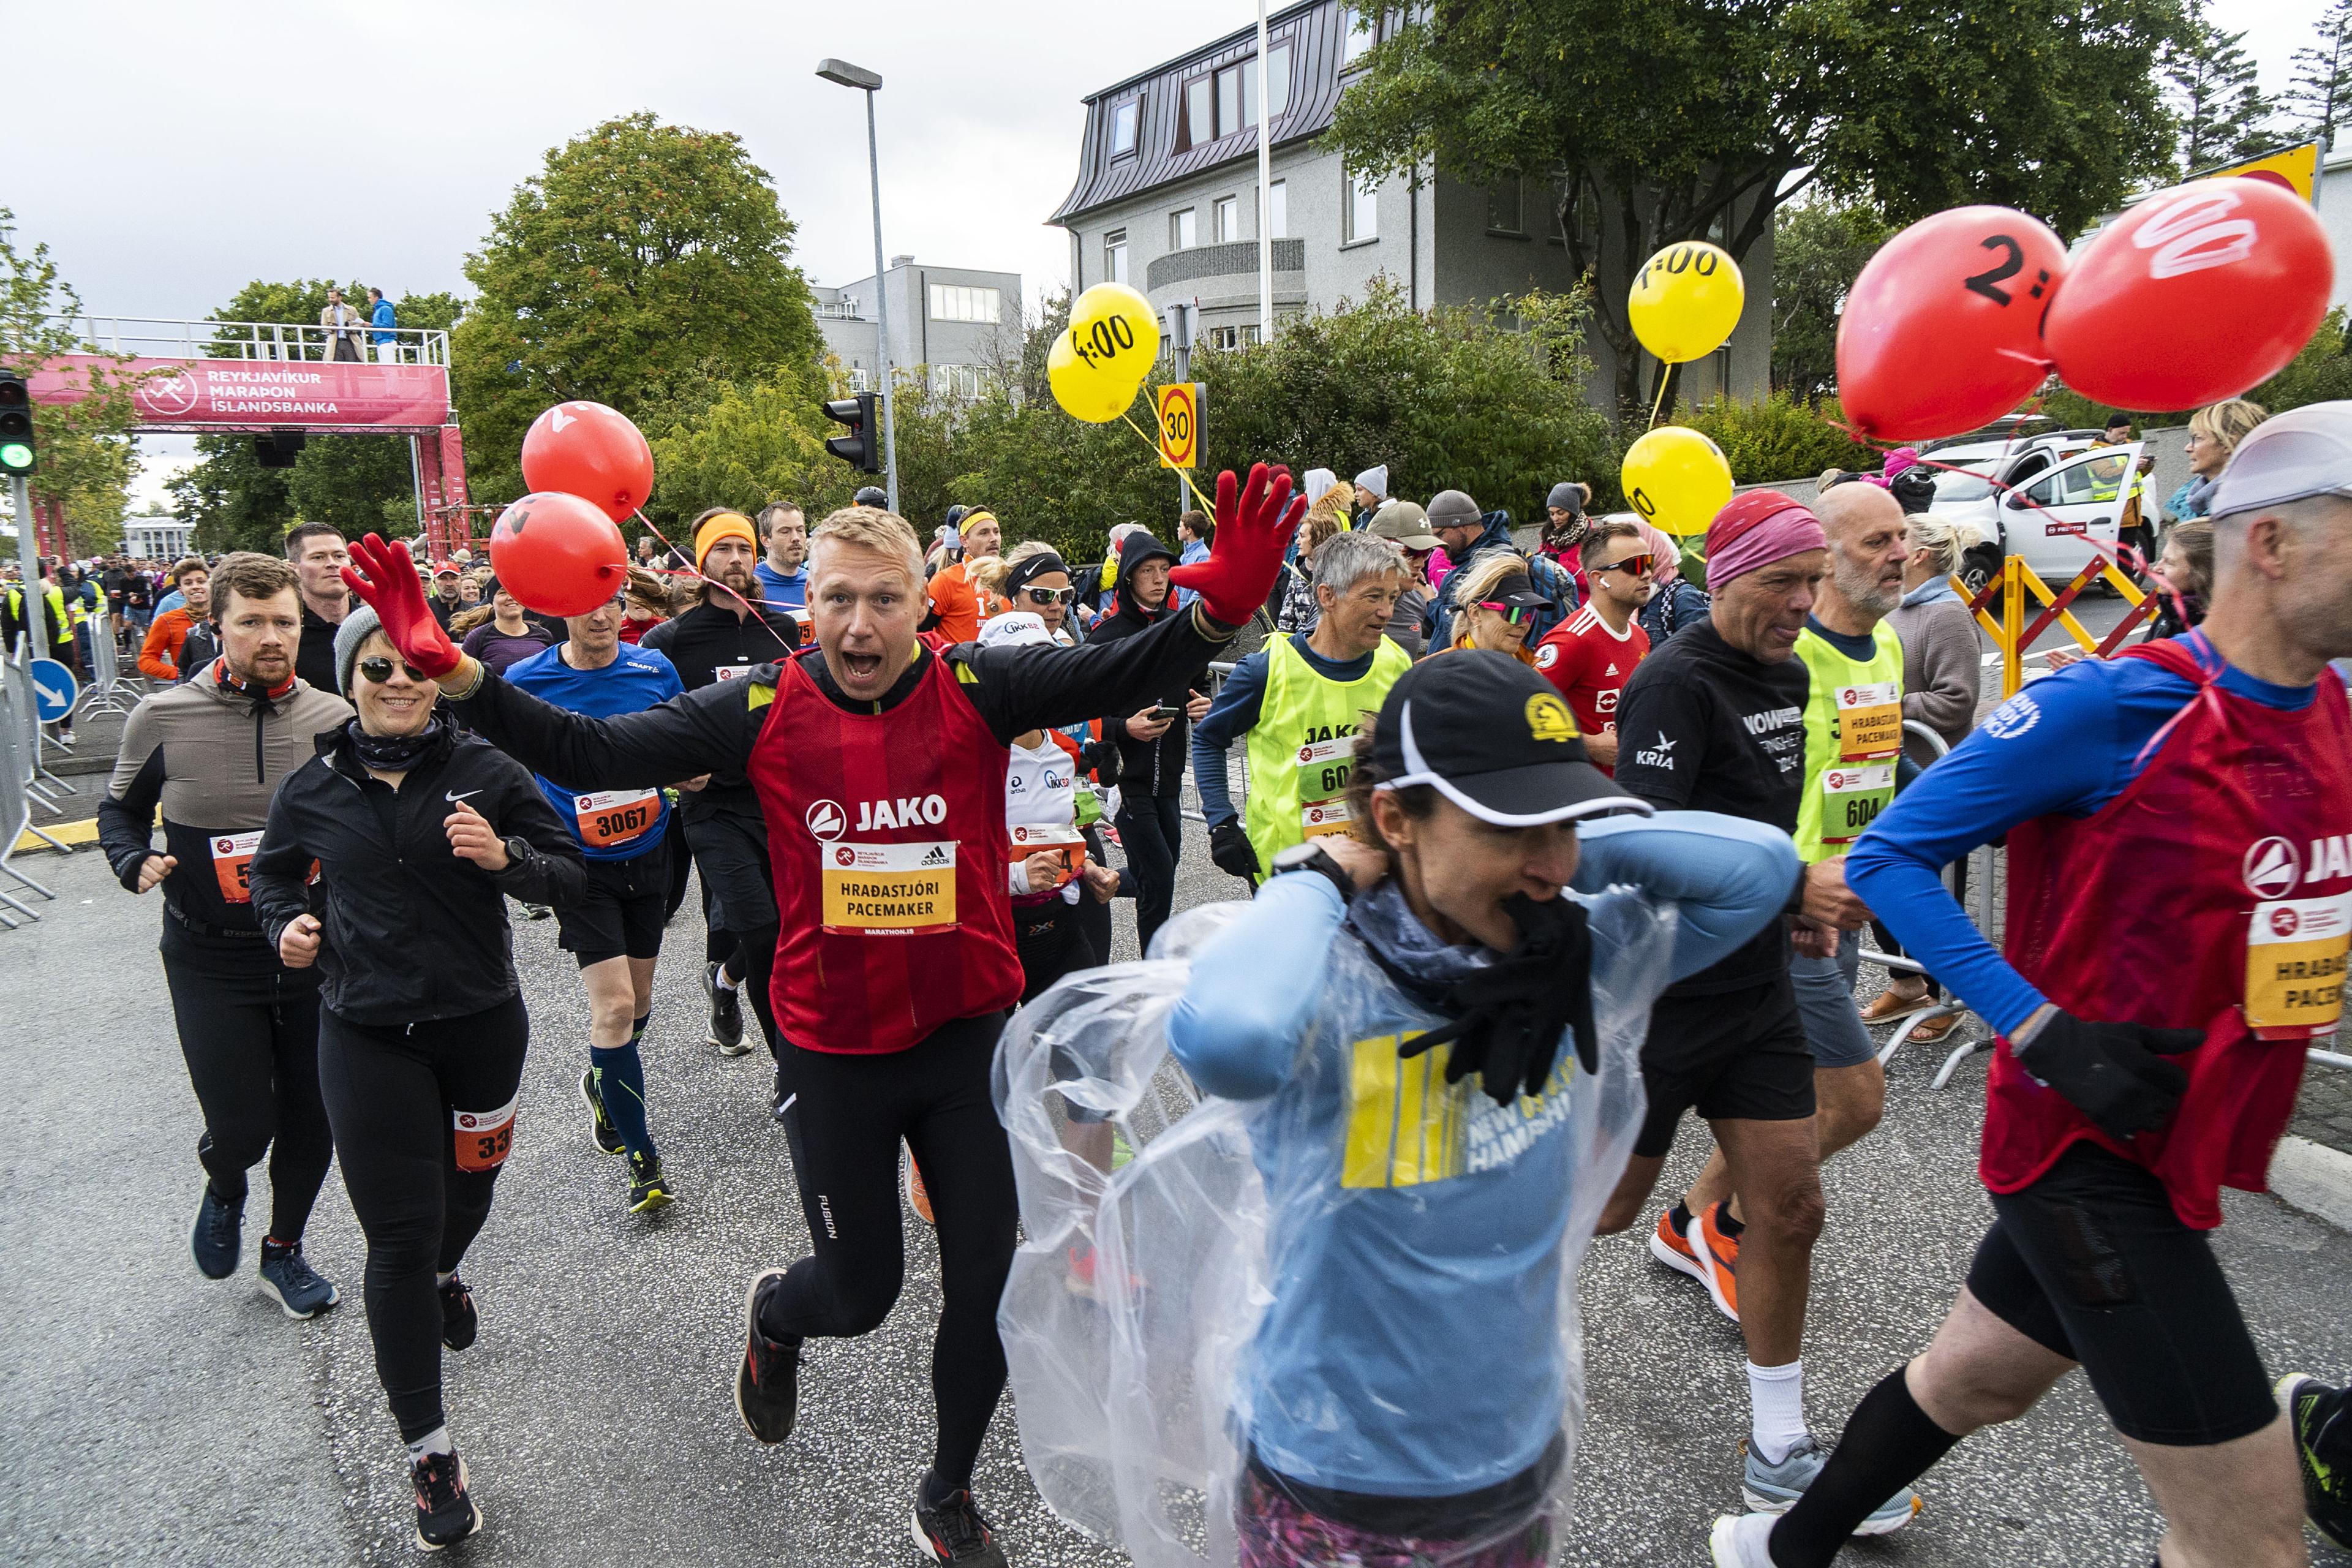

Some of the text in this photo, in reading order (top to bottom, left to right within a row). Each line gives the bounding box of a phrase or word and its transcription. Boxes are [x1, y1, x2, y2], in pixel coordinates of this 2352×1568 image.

[1073, 314, 1133, 369] 4:00
[207, 369, 321, 383] REYKJAVÍKUR
[209, 385, 296, 398] MARAÞON
[211, 398, 339, 413] ÍSLANDSBANKA
[1167, 411, 1188, 440] 30
[627, 662, 654, 671] CRAFT
[1321, 764, 1355, 792] 60
[597, 806, 647, 838] 3067
[856, 794, 948, 832] JAKO
[1846, 797, 1879, 828] 604
[921, 858, 950, 866] adidas
[2304, 833, 2352, 883] JA
[841, 880, 939, 898] HRAÐASTJÓRI
[847, 902, 934, 916] PACEMAKER
